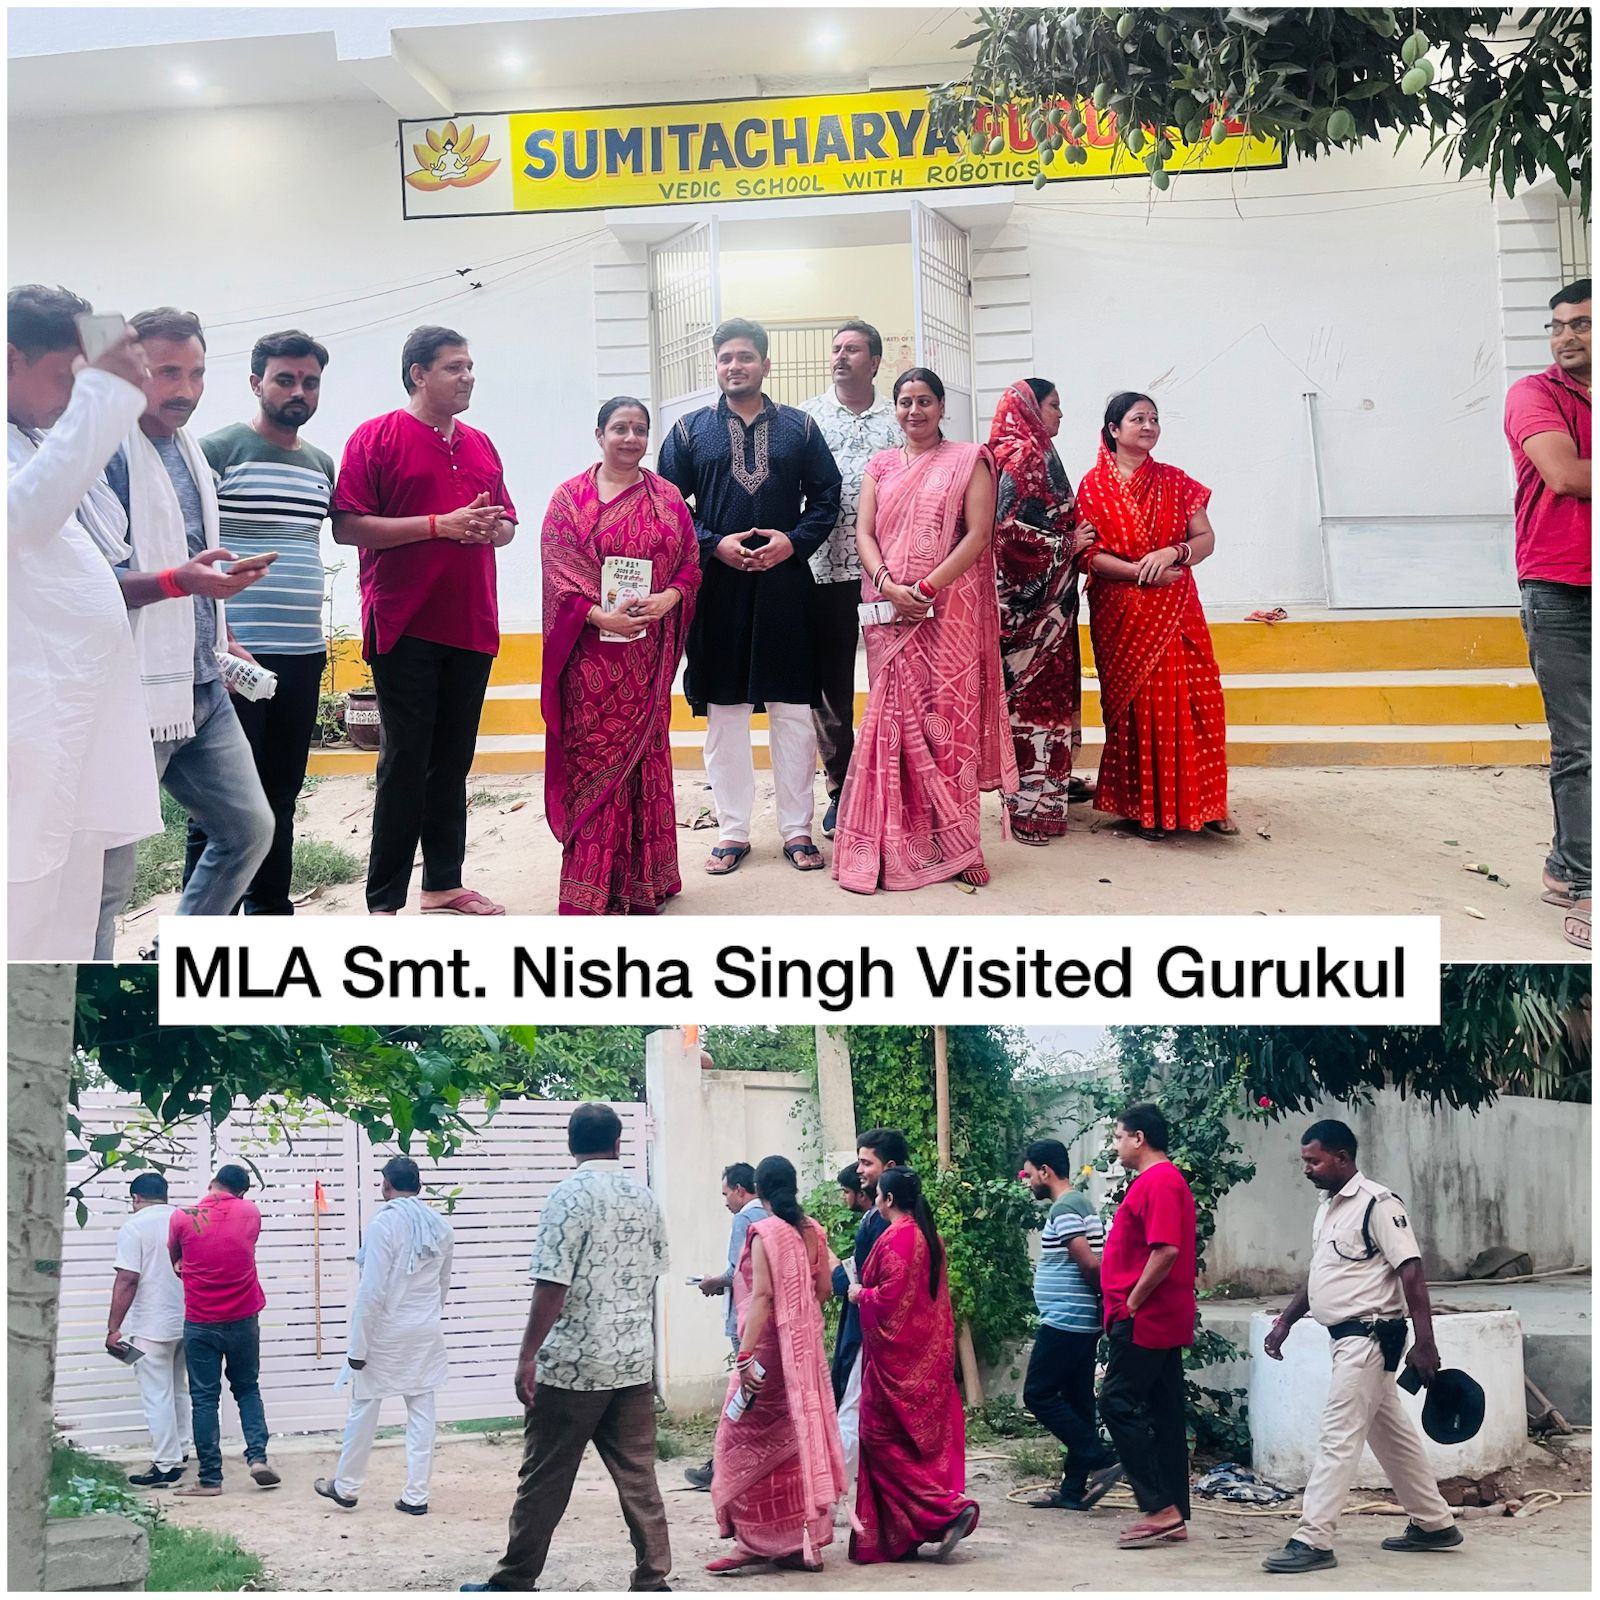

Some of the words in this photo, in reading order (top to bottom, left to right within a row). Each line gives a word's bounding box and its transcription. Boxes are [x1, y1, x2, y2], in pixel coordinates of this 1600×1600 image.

[523, 107, 961, 179] SUMITACHARYA
[658, 180, 721, 200] VEDIC
[735, 174, 825, 197] SCHOOL
[843, 168, 903, 189] WITH
[926, 159, 1041, 184] ROBOTICS
